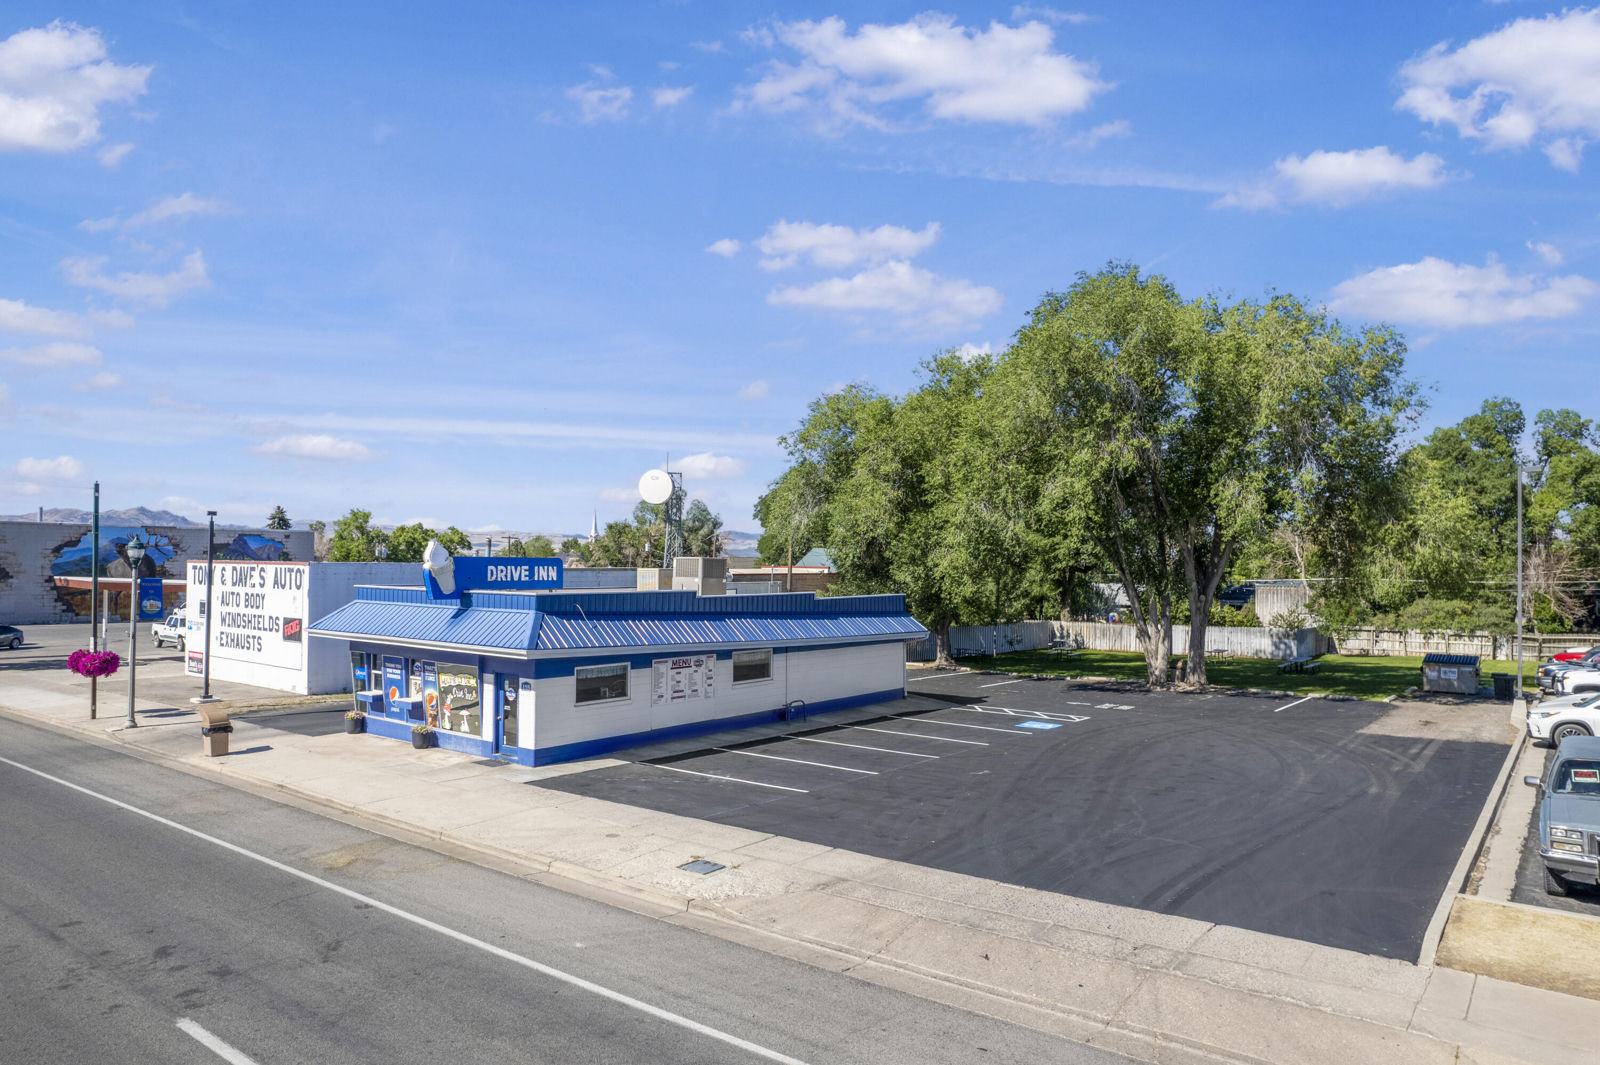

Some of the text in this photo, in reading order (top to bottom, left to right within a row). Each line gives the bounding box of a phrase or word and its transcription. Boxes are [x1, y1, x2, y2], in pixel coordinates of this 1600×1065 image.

[221, 566, 227, 586] &
[232, 564, 266, 588] DAVE'S
[487, 565, 557, 582] DRIVE INN
[220, 591, 266, 610] AUTO BODY
[220, 611, 280, 633] WINDSHIELDS
[219, 631, 263, 652] EXHAUSTS
[671, 658, 692, 667] MENU
